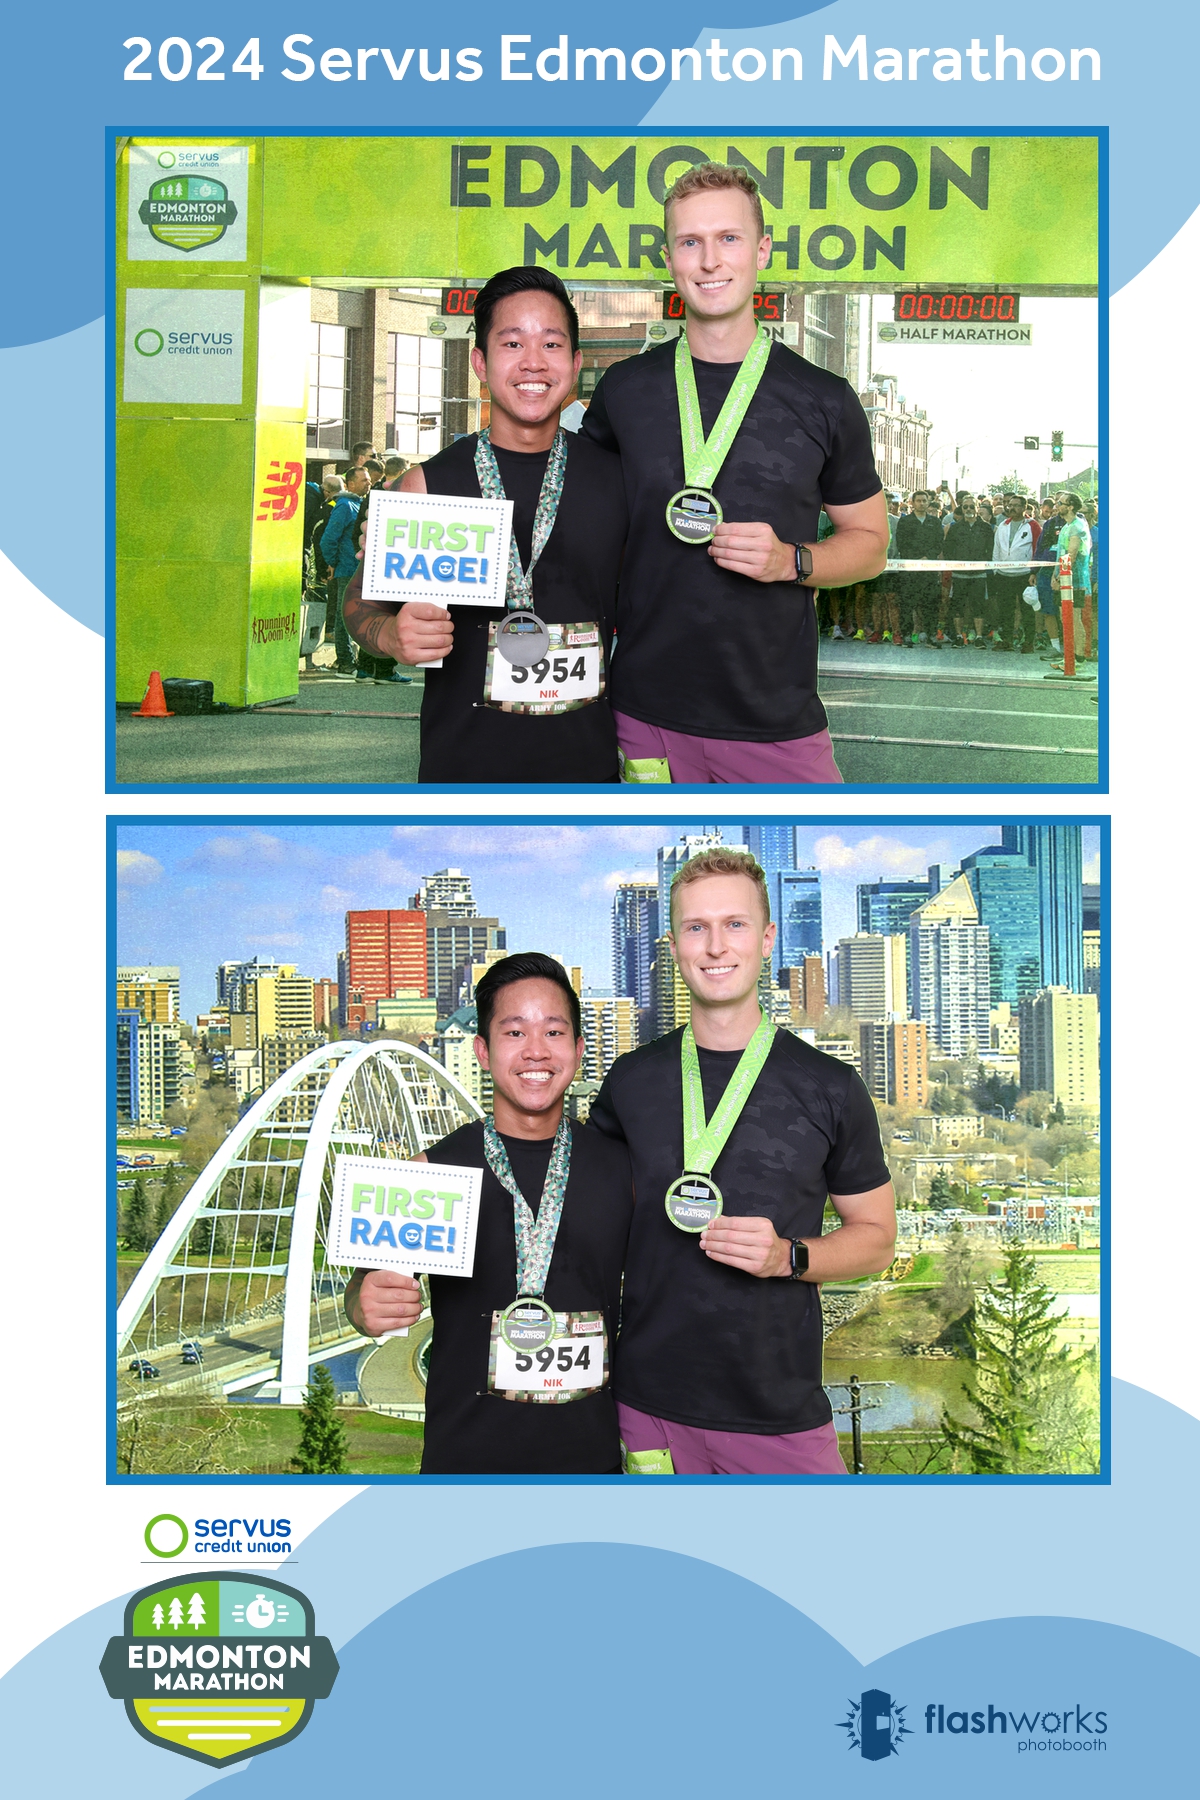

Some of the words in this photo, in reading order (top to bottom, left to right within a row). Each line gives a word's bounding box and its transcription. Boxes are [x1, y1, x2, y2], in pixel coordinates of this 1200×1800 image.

[178, 152, 220, 161] servus
[149, 202, 227, 214] EDMONTON
[160, 214, 215, 222] MARATHON
[523, 222, 906, 271] MARHON
[168, 331, 233, 345] servus
[900, 328, 939, 340] HALF
[943, 328, 1030, 341] MARATHON
[168, 345, 200, 355] credit
[203, 347, 233, 355] union
[550, 470, 559, 489] ARMY
[385, 518, 495, 553] FIRST
[384, 552, 489, 584] RACE!
[257, 615, 290, 643] Running
[511, 656, 586, 684] 5954
[539, 690, 559, 698] NIK
[529, 704, 552, 712] ARMY
[554, 703, 567, 711] 10K
[557, 1156, 565, 1175] ARMY
[351, 1183, 463, 1222] FIRST
[350, 1217, 456, 1253] RACE!
[515, 1345, 591, 1373] 5954
[543, 1378, 563, 1387] NIK
[558, 1392, 571, 1400] 10K
